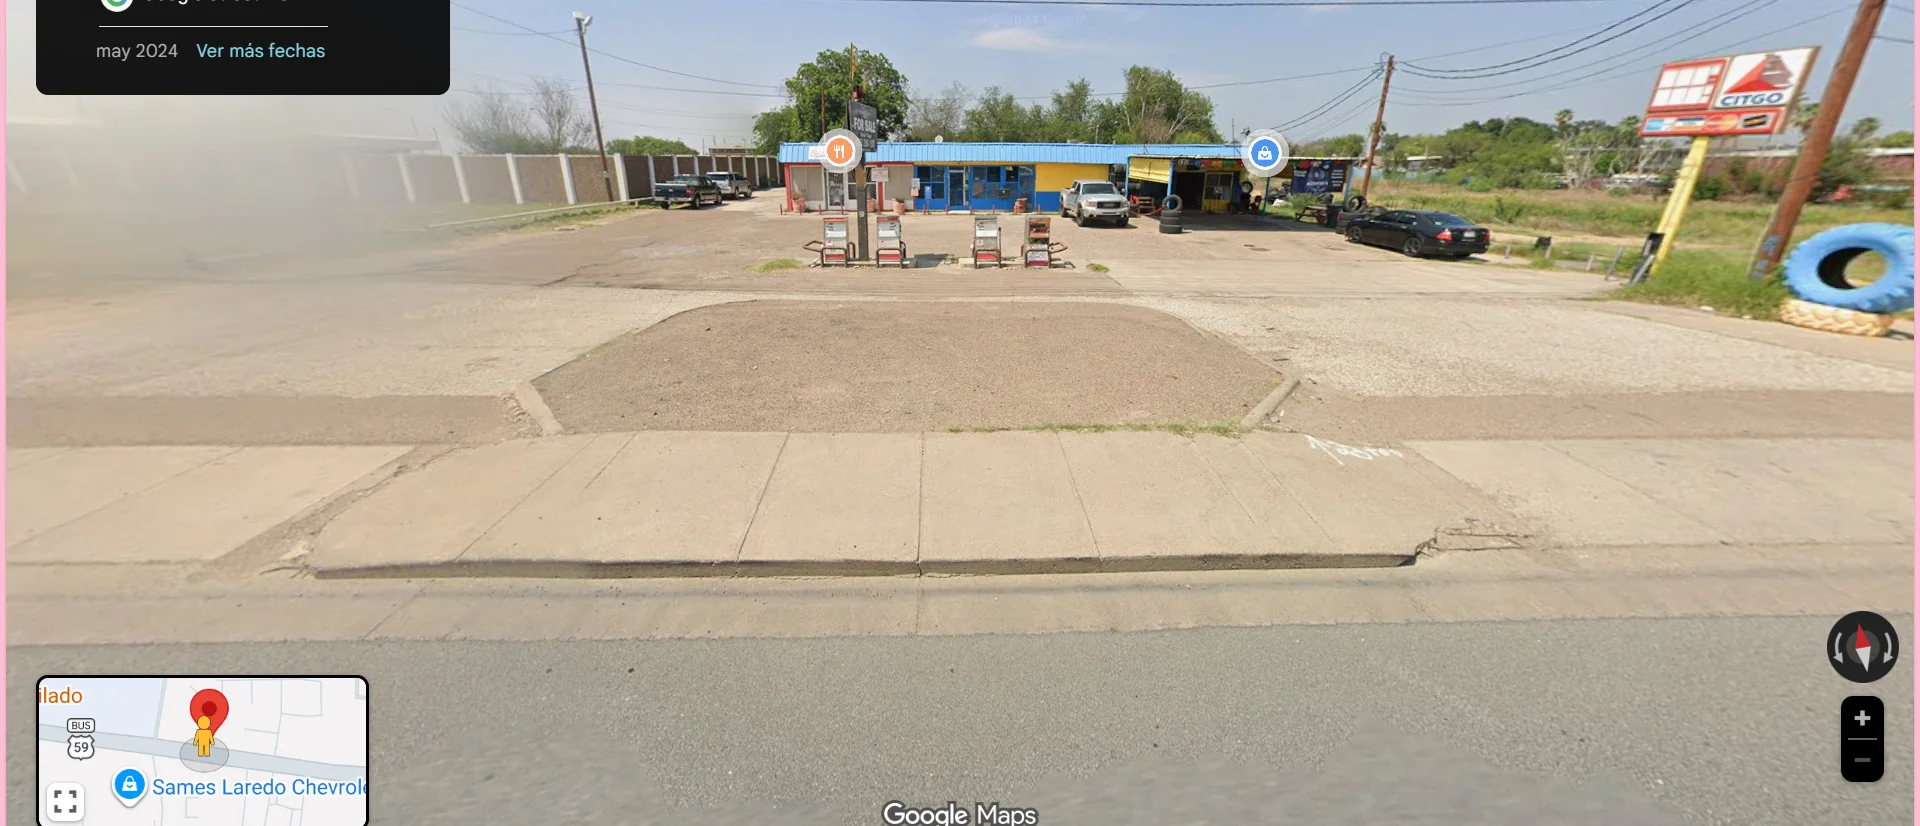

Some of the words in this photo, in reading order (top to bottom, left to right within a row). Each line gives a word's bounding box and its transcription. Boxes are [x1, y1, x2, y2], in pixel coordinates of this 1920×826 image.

[1720, 92, 1783, 106] CITGO
[853, 117, 864, 131] FOR
[865, 120, 876, 133] SALE
